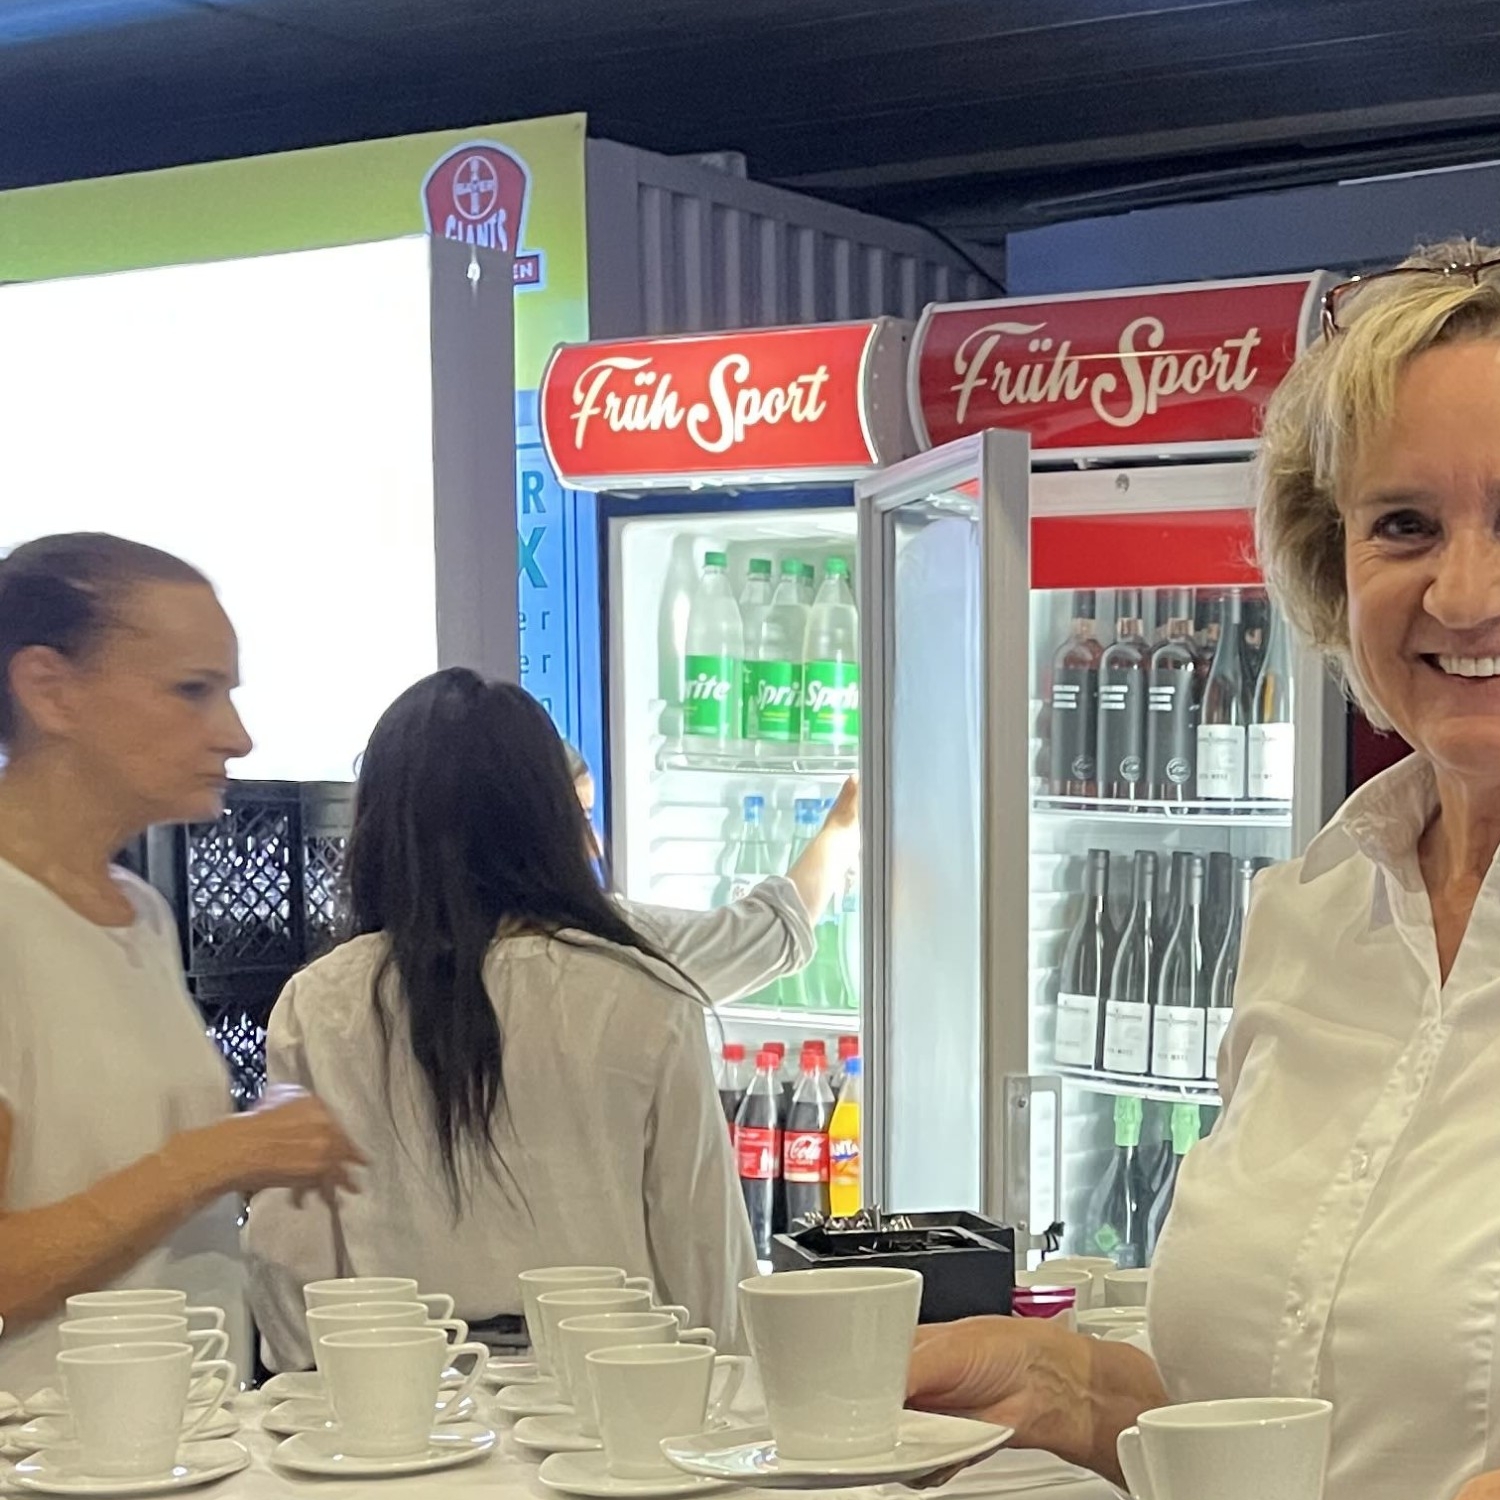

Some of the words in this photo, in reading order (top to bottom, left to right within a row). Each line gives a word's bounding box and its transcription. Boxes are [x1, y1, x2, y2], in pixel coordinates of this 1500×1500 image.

[569, 356, 685, 450] Früh
[686, 353, 830, 454] Sport
[950, 321, 1089, 425] Früh
[1090, 316, 1262, 428] Sport
